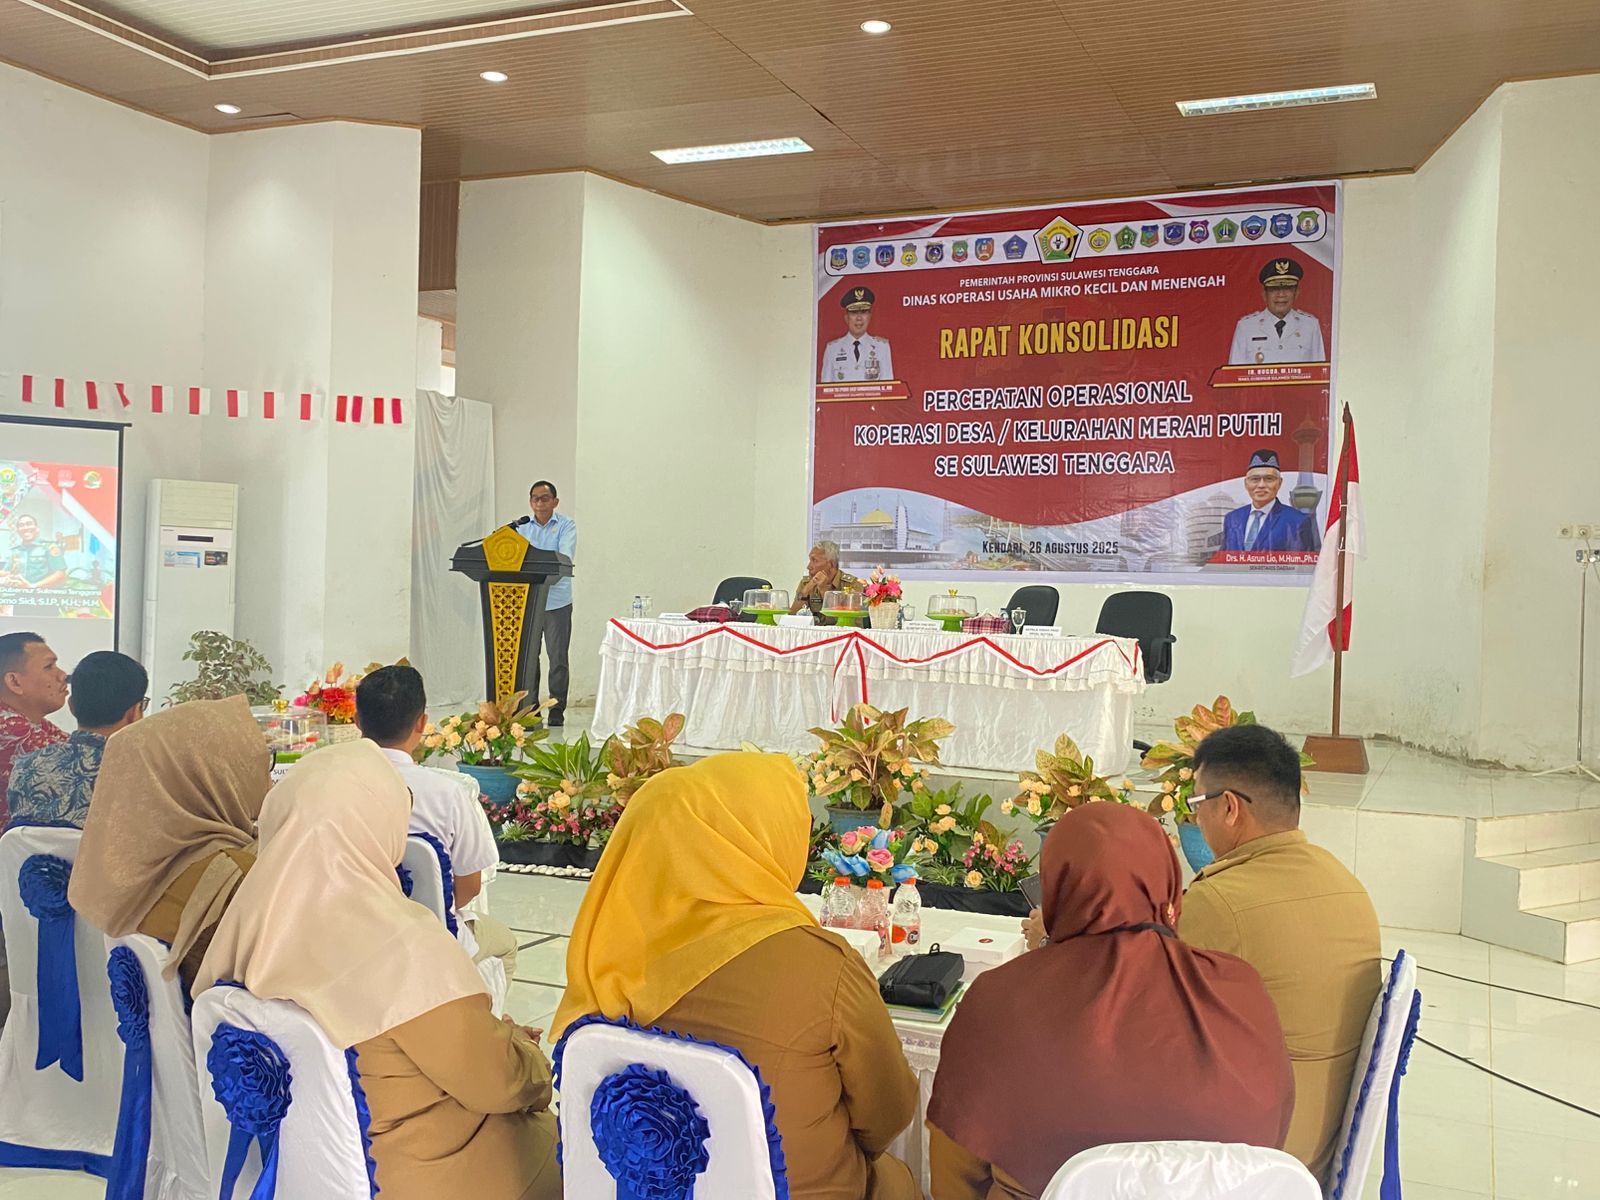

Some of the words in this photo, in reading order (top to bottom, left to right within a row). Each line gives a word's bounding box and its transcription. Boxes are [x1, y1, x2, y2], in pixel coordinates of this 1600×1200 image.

[902, 295, 937, 307] DINAS
[939, 290, 995, 304] KOPERASI
[998, 287, 1038, 300] USAHA
[1040, 283, 1081, 297] MIKRO
[1084, 281, 1118, 294] KECIL
[1120, 278, 1149, 292] DAN
[1151, 274, 1226, 290] MENENGAH
[959, 276, 1015, 288] PEMERINTAH
[1016, 273, 1059, 284] PROVINSI
[1060, 269, 1107, 281] SULAWESI
[1108, 265, 1160, 277] TENGGARA
[939, 325, 1011, 359] RAPAT
[1018, 315, 1179, 355] KONSOLIDASI
[924, 387, 1042, 411] PERCEPATAN
[1047, 380, 1192, 408] OPERASIONAL
[853, 422, 941, 446] KOPERASI
[945, 421, 994, 443] DESA
[998, 419, 1010, 445] /
[1013, 417, 1134, 441] KELURAHAN
[1138, 415, 1211, 438] MERAH
[1217, 413, 1282, 437] PUTIH
[934, 457, 958, 477] SE
[961, 454, 1058, 476] SULAWESI
[1062, 451, 1175, 474] TENGGARA
[1029, 541, 1042, 554] 26
[1045, 542, 1089, 554] AGUSTUS
[1092, 541, 1119, 554] 2025
[1225, 553, 1238, 563] Drs.
[1239, 553, 1246, 563] H.
[1247, 553, 1266, 563] Asrun
[1267, 552, 1278, 564] Lio,
